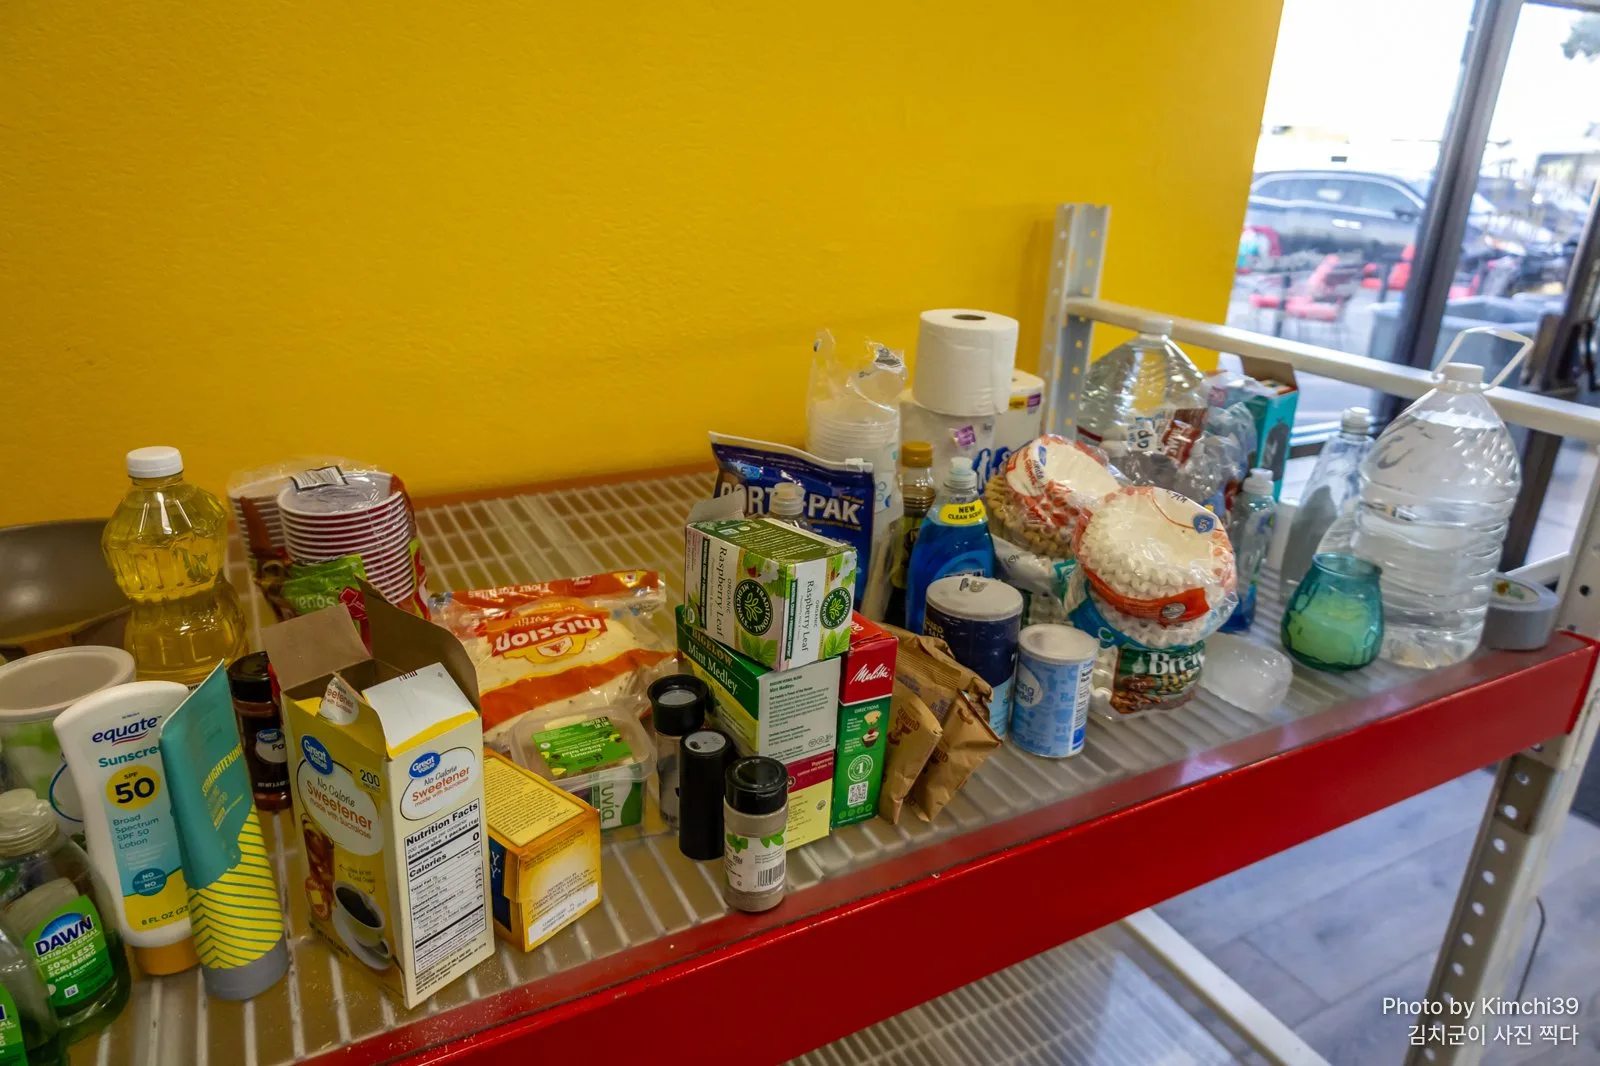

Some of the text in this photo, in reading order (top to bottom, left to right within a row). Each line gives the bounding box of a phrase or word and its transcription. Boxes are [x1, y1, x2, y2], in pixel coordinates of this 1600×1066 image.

[958, 505, 975, 513] NEW
[715, 546, 728, 639] Raspberry Leaf
[801, 580, 815, 652] Raspberry Leaf
[688, 640, 738, 695] Mint Medley
[849, 663, 890, 684] Melitta
[92, 717, 158, 742] equate
[304, 739, 326, 760] Great
[412, 755, 435, 771] Great
[124, 771, 138, 780] SPF
[360, 769, 380, 787] 200
[412, 766, 470, 802] Sweetener
[423, 765, 457, 786] No Calorie
[114, 777, 155, 804] 50
[316, 777, 328, 791] No
[328, 784, 356, 808] Calorie
[306, 780, 372, 830] Sweetener
[113, 814, 141, 826] Broad
[115, 817, 160, 834] Spectrum
[406, 803, 478, 846] Nutrition Facts
[116, 828, 150, 842] SPF 50
[119, 838, 148, 849] Lotion
[408, 845, 430, 860] Serving
[430, 838, 442, 847] size
[409, 853, 447, 878] Calories
[472, 831, 480, 841] 0
[144, 880, 157, 888] NO
[161, 911, 174, 920] OZ
[34, 915, 94, 956] DAWN
[47, 943, 95, 970] 50% LESS
[49, 949, 97, 977] SCRUBBING
